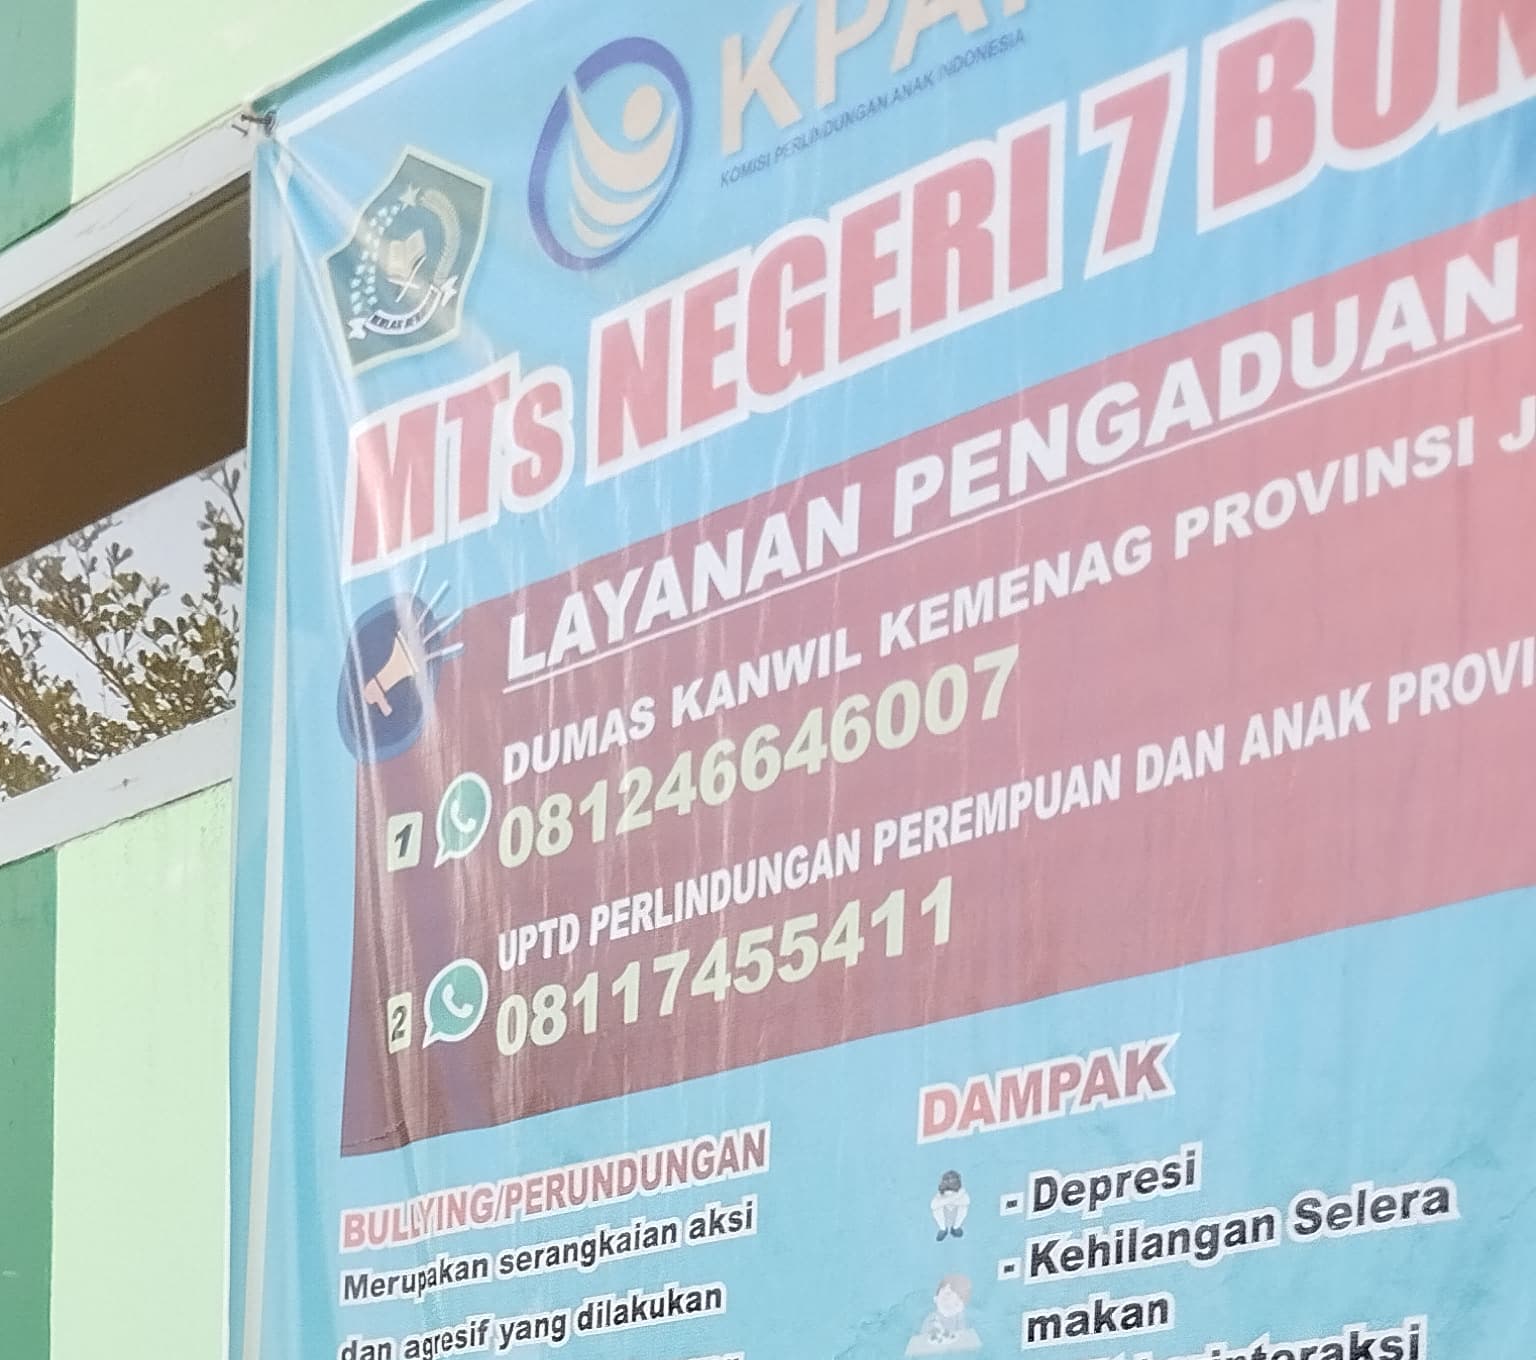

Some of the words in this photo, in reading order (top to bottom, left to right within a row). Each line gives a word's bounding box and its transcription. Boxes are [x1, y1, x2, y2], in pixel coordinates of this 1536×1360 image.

[721, 153, 770, 188] KOMISI
[892, 70, 935, 103] ANAK
[350, 372, 564, 566] MTs
[597, 124, 1051, 468] NEGERI
[1094, 73, 1172, 257] 7
[507, 483, 860, 682] LAYANAN
[893, 235, 1519, 538] PENGADUAN
[503, 697, 654, 786] DUMAS
[671, 628, 862, 729] KANWIL
[880, 525, 1152, 657] KEMENAG
[1174, 415, 1474, 560] PROVINSI
[393, 822, 413, 859] 1
[498, 644, 1020, 869] 081246646007
[498, 916, 580, 972] UPTD
[589, 830, 860, 947] PERLINDUNGAN
[874, 754, 1121, 866] PEREMPUAN
[1136, 726, 1224, 796] DAN
[1240, 683, 1373, 766] ANAK
[1387, 634, 1536, 725] PROVI
[496, 876, 953, 1057] 08117455411
[922, 1043, 1170, 1138] DAMPAK
[343, 1128, 767, 1249] BULLYING/PERUNDUNGAN
[1029, 1209, 1275, 1278] Kehilangan
[1293, 1184, 1451, 1236] Selera
[1031, 1150, 1196, 1213] Depresi
[344, 1254, 488, 1301] Merupakan
[499, 1221, 677, 1276] serangkaian
[688, 1200, 754, 1242] aksi
[499, 1311, 566, 1351] yang
[577, 1285, 722, 1332] dilakukan
[1027, 1295, 1169, 1343] makan
